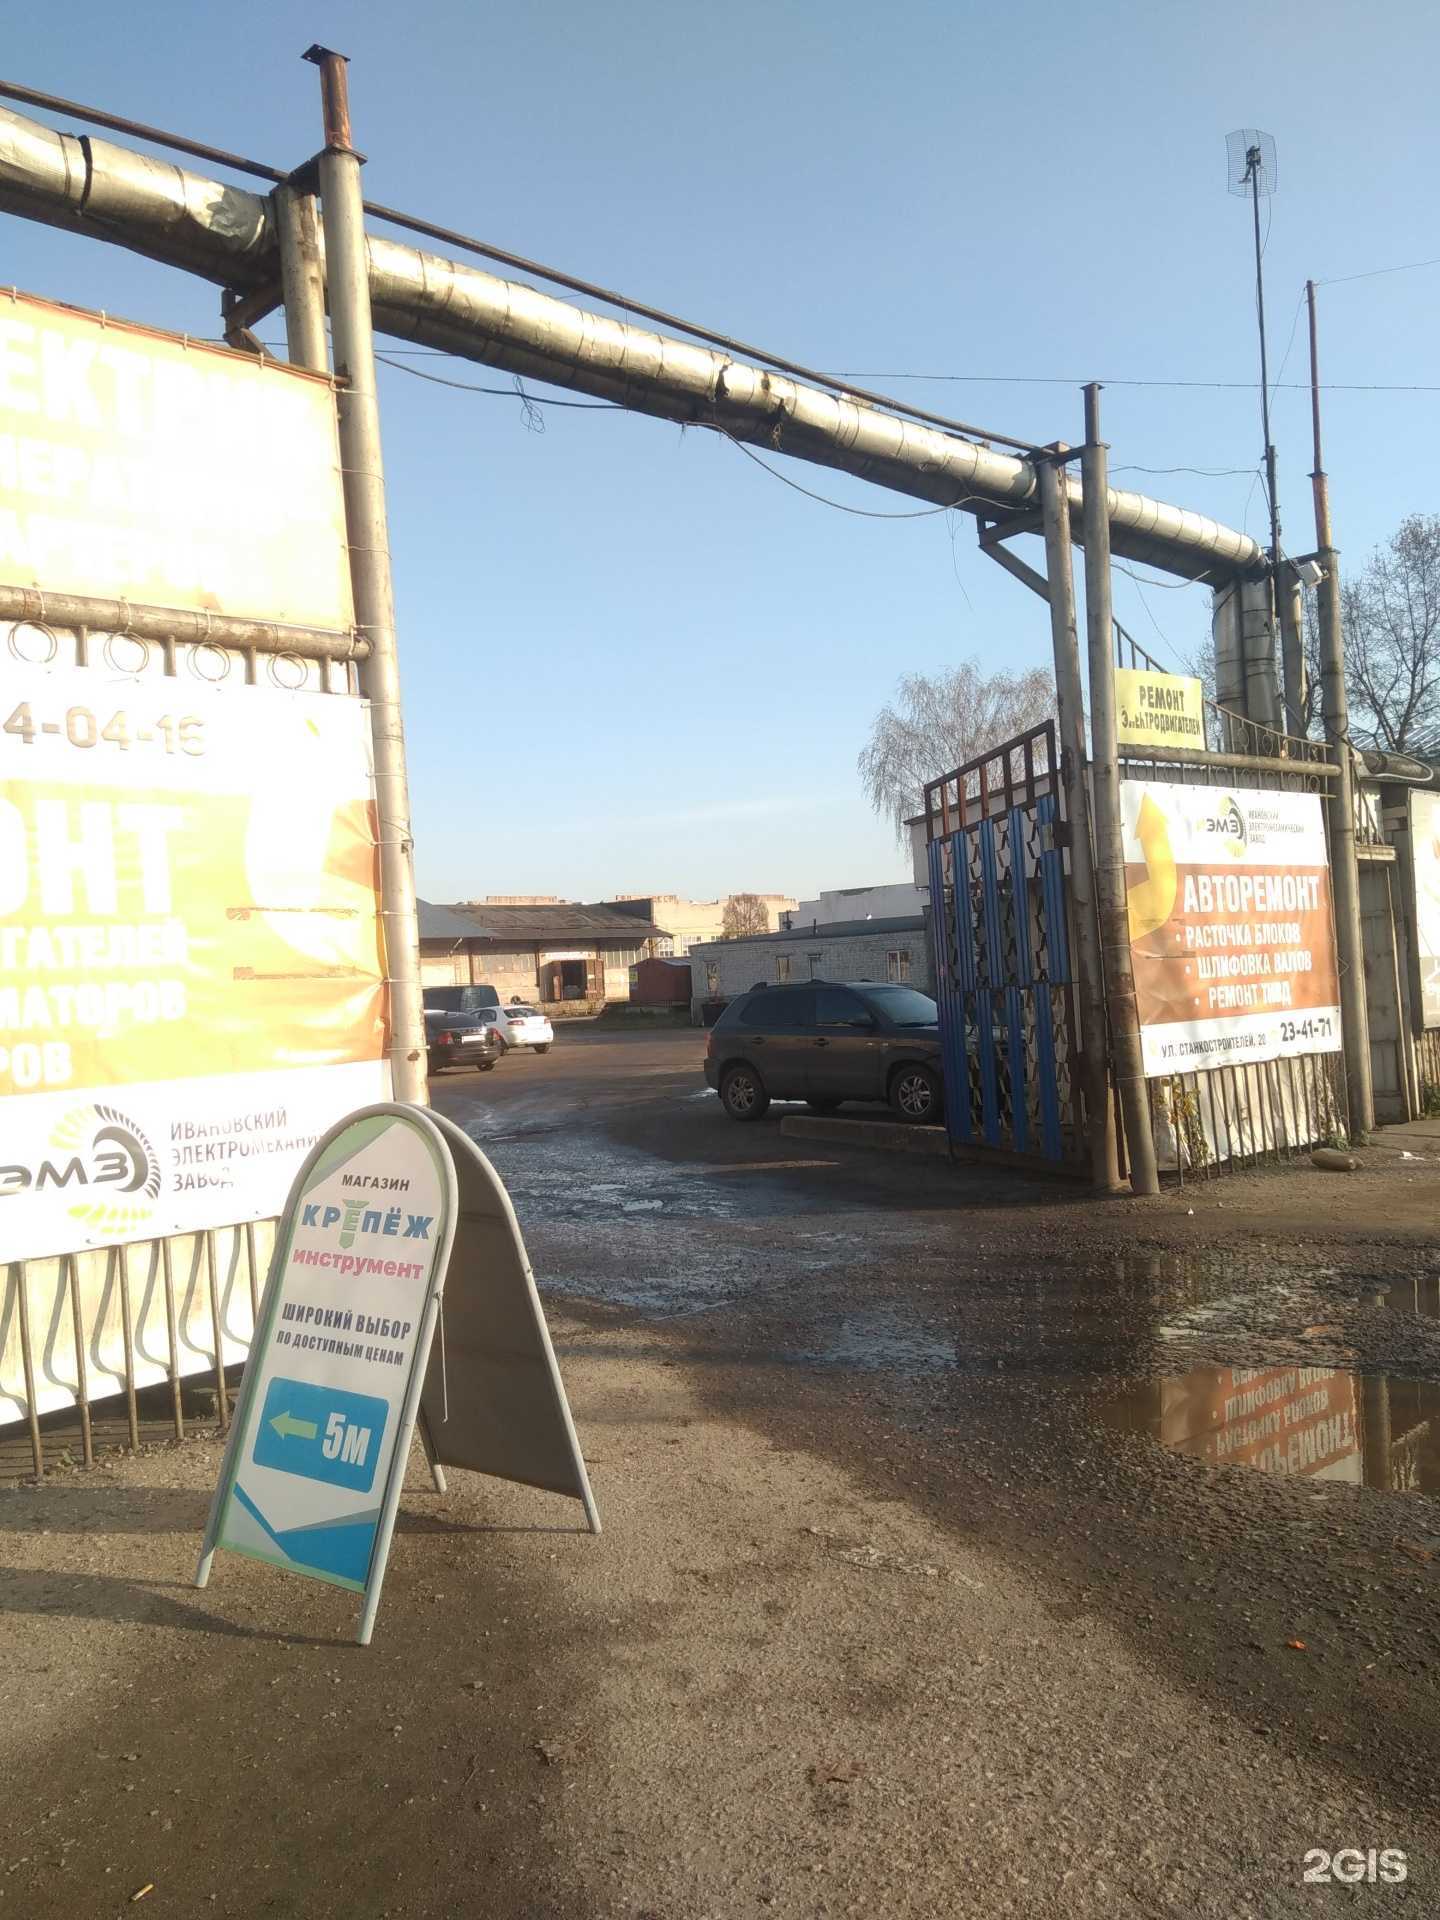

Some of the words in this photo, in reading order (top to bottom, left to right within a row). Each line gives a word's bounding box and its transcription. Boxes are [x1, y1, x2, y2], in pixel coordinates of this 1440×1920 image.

[1139, 685, 1185, 712] РЕМОНТ
[1121, 709, 1201, 736] ЭЛЕКТРОДВИГАТЕЛЕЙ
[1206, 818, 1239, 833] ЭМЗ
[1183, 874, 1319, 913] АВТОРЕМОНТ
[1185, 923, 1252, 949] РАСТОЧКА
[1254, 922, 1301, 945] БЛОКОВ
[1197, 952, 1271, 979] ШЛИФОВКА
[1274, 950, 1313, 974] ВАЛОВ
[1208, 984, 1257, 1009] РЕМОНТ
[1280, 1018, 1332, 1042] 23-41-71
[170, 1105, 288, 1141] ИВАНОВСКИЙ
[341, 1174, 411, 1192] МАГАЗИН
[301, 1202, 434, 1241] КРЕПЁЖ
[292, 1249, 424, 1279] инструмент
[281, 1302, 353, 1331] ШИРОКИЙ
[355, 1314, 411, 1340] ВЫБОР
[276, 1330, 291, 1345] ПО
[292, 1333, 363, 1358] ДОСТУПНЫМ
[365, 1347, 405, 1367] ЦЕНАМ
